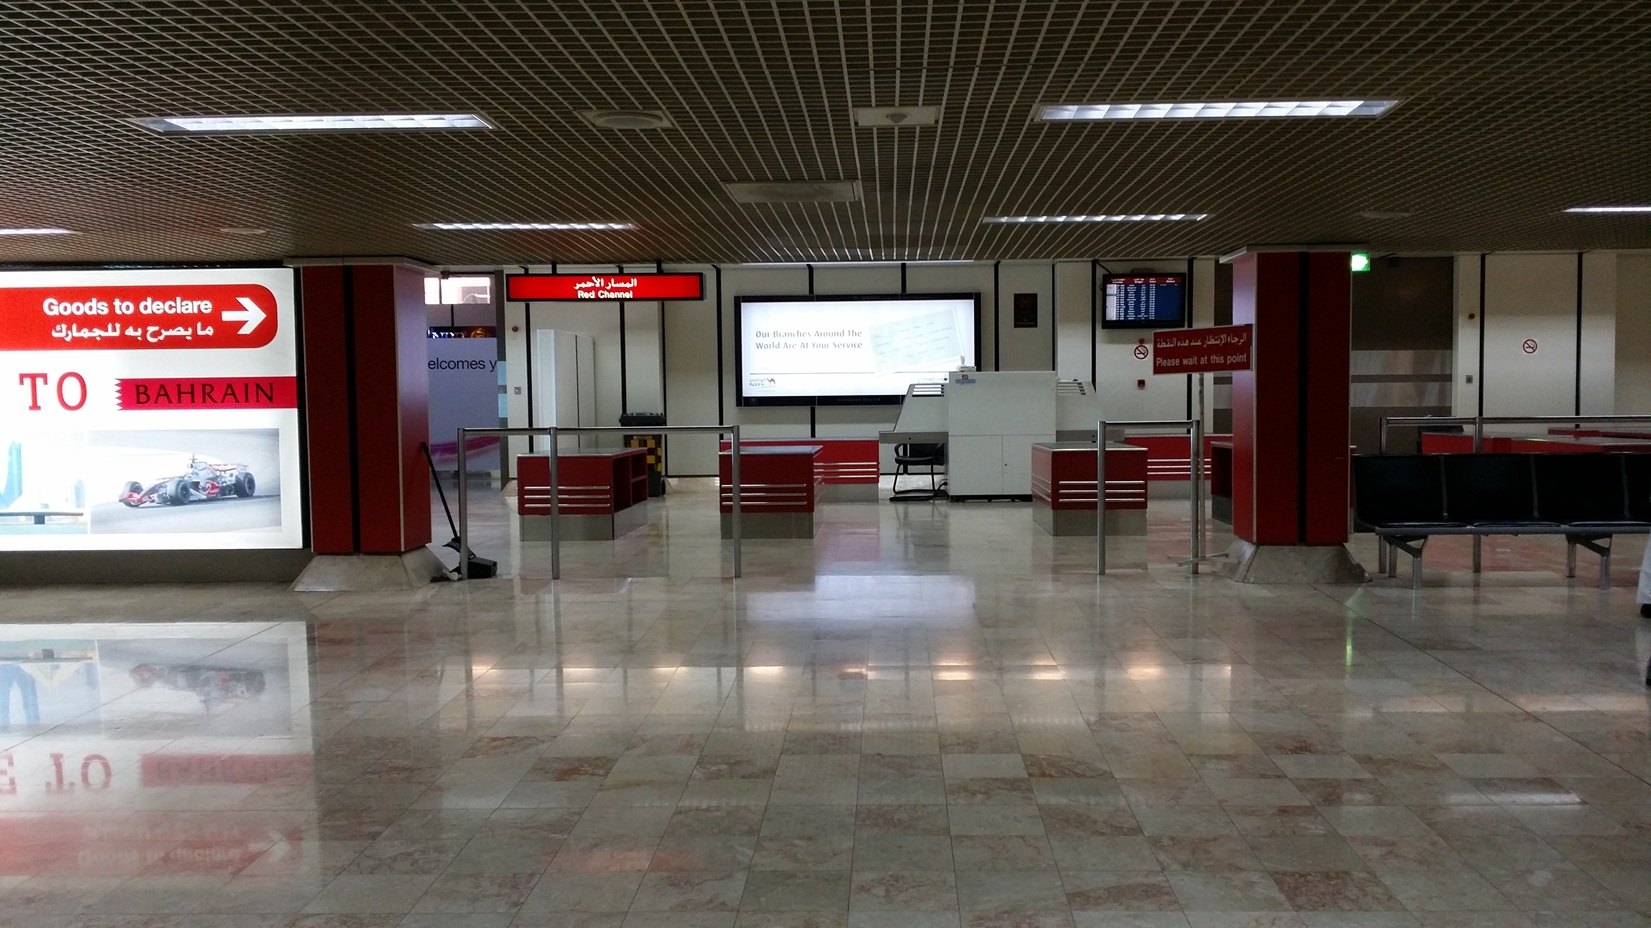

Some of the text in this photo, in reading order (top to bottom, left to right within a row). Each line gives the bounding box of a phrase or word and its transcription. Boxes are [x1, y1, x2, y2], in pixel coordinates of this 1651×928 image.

[573, 276, 638, 290] المسار الأحمر
[577, 290, 633, 299] Red Channel
[42, 297, 213, 317] Goods to declare
[51, 322, 214, 342] ما يصرح به للجمارك
[755, 329, 863, 339] Our Branches Around The
[1227, 332, 1247, 346] الرجاء
[755, 341, 863, 350] World Are At Your Service
[1156, 337, 1177, 348] النقطة
[1177, 336, 1189, 347] هذه
[1156, 353, 1247, 367] Please wait at this point
[18, 371, 274, 412] TO BAHRAIN
